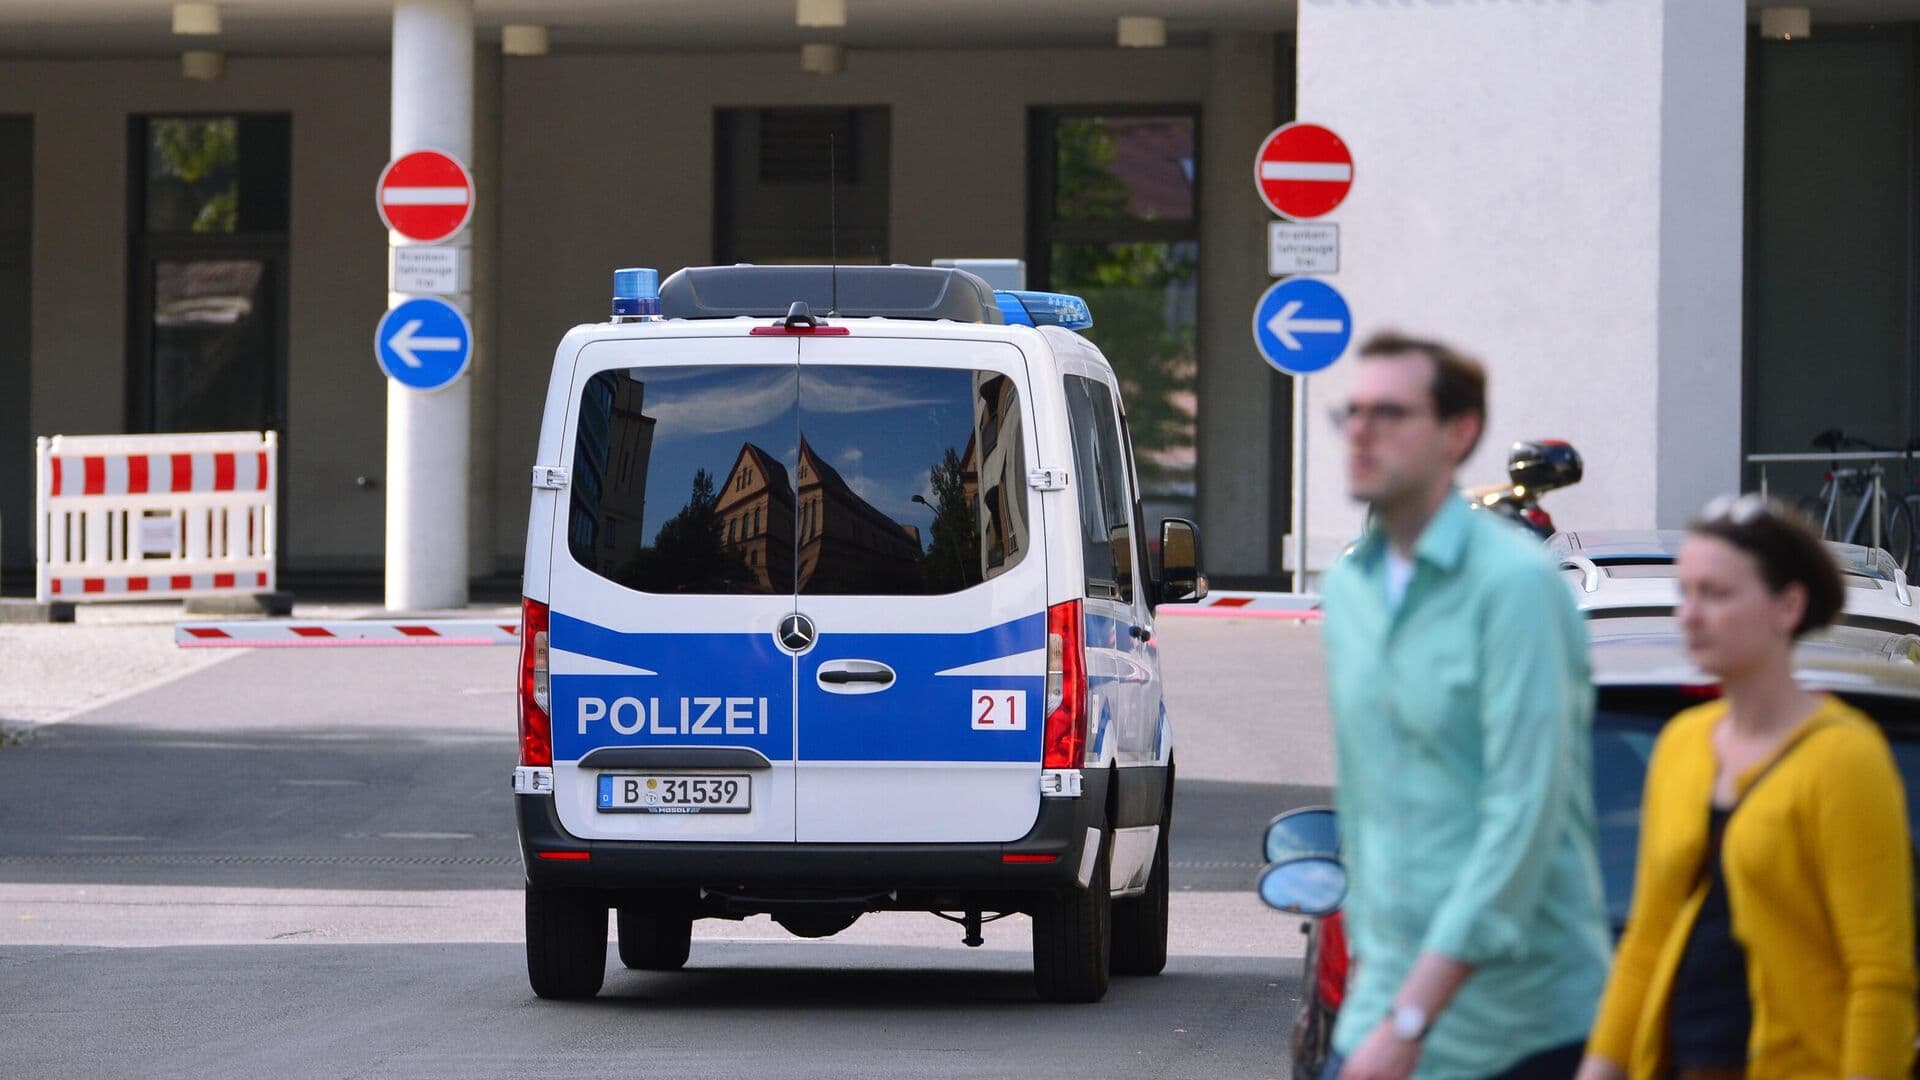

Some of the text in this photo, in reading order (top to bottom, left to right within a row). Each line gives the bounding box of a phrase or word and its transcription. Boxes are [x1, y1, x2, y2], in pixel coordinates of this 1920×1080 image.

[577, 696, 768, 735] POLIZEI
[977, 695, 1015, 725] 21
[624, 780, 739, 804] B 31539
